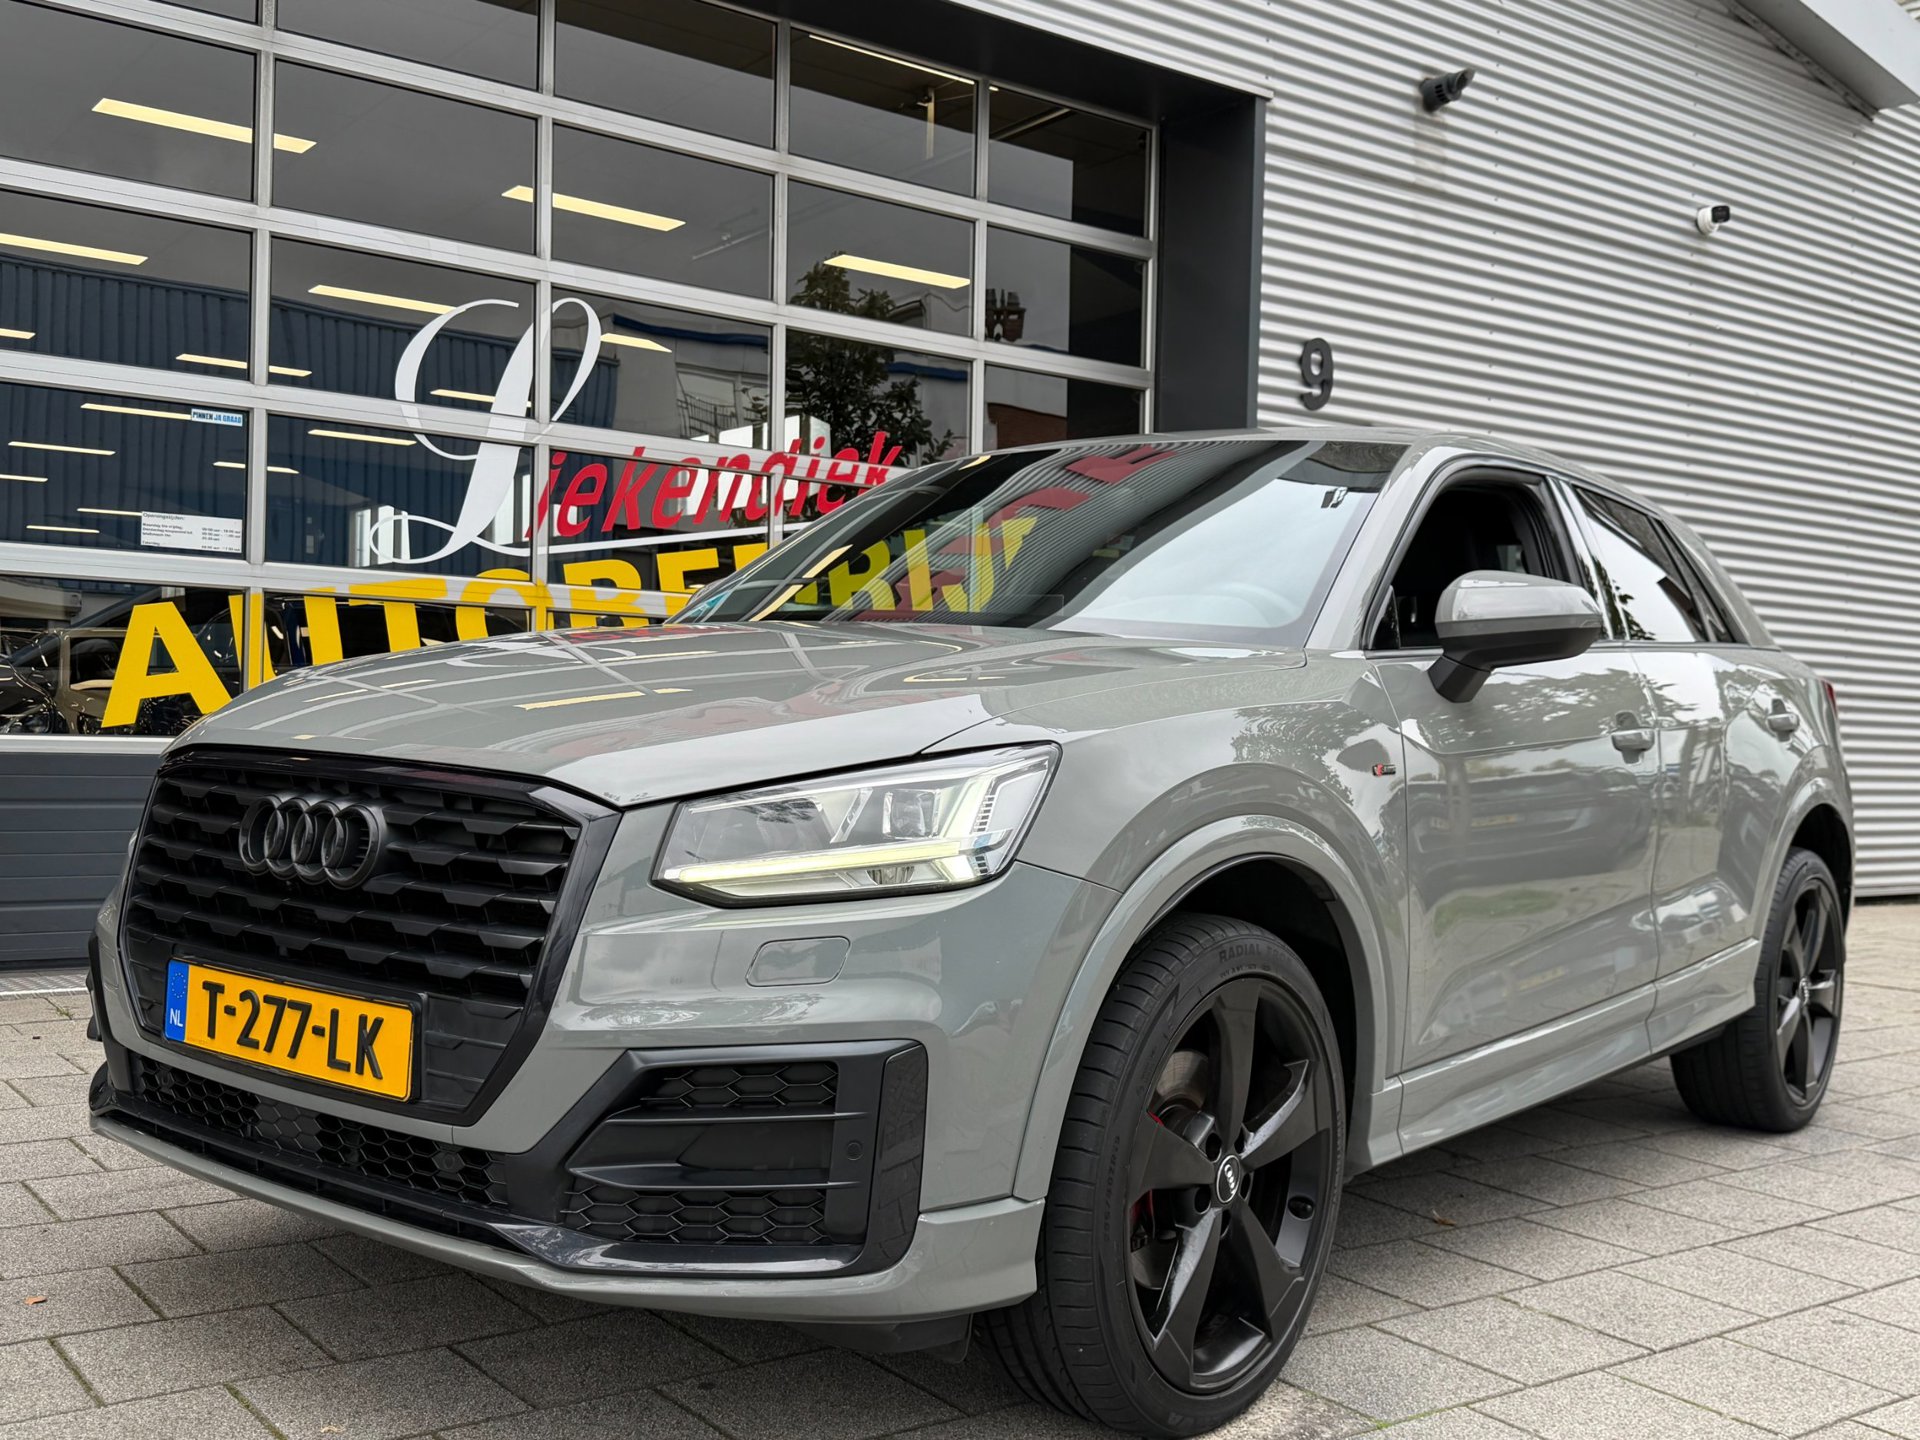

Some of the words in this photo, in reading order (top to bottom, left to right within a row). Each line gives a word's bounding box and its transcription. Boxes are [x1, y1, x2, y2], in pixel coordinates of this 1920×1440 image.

[1299, 337, 1334, 411] 9
[1219, 943, 1262, 962] RADIAL
[169, 1007, 184, 1027] NL
[202, 980, 384, 1080] T-277-LK
